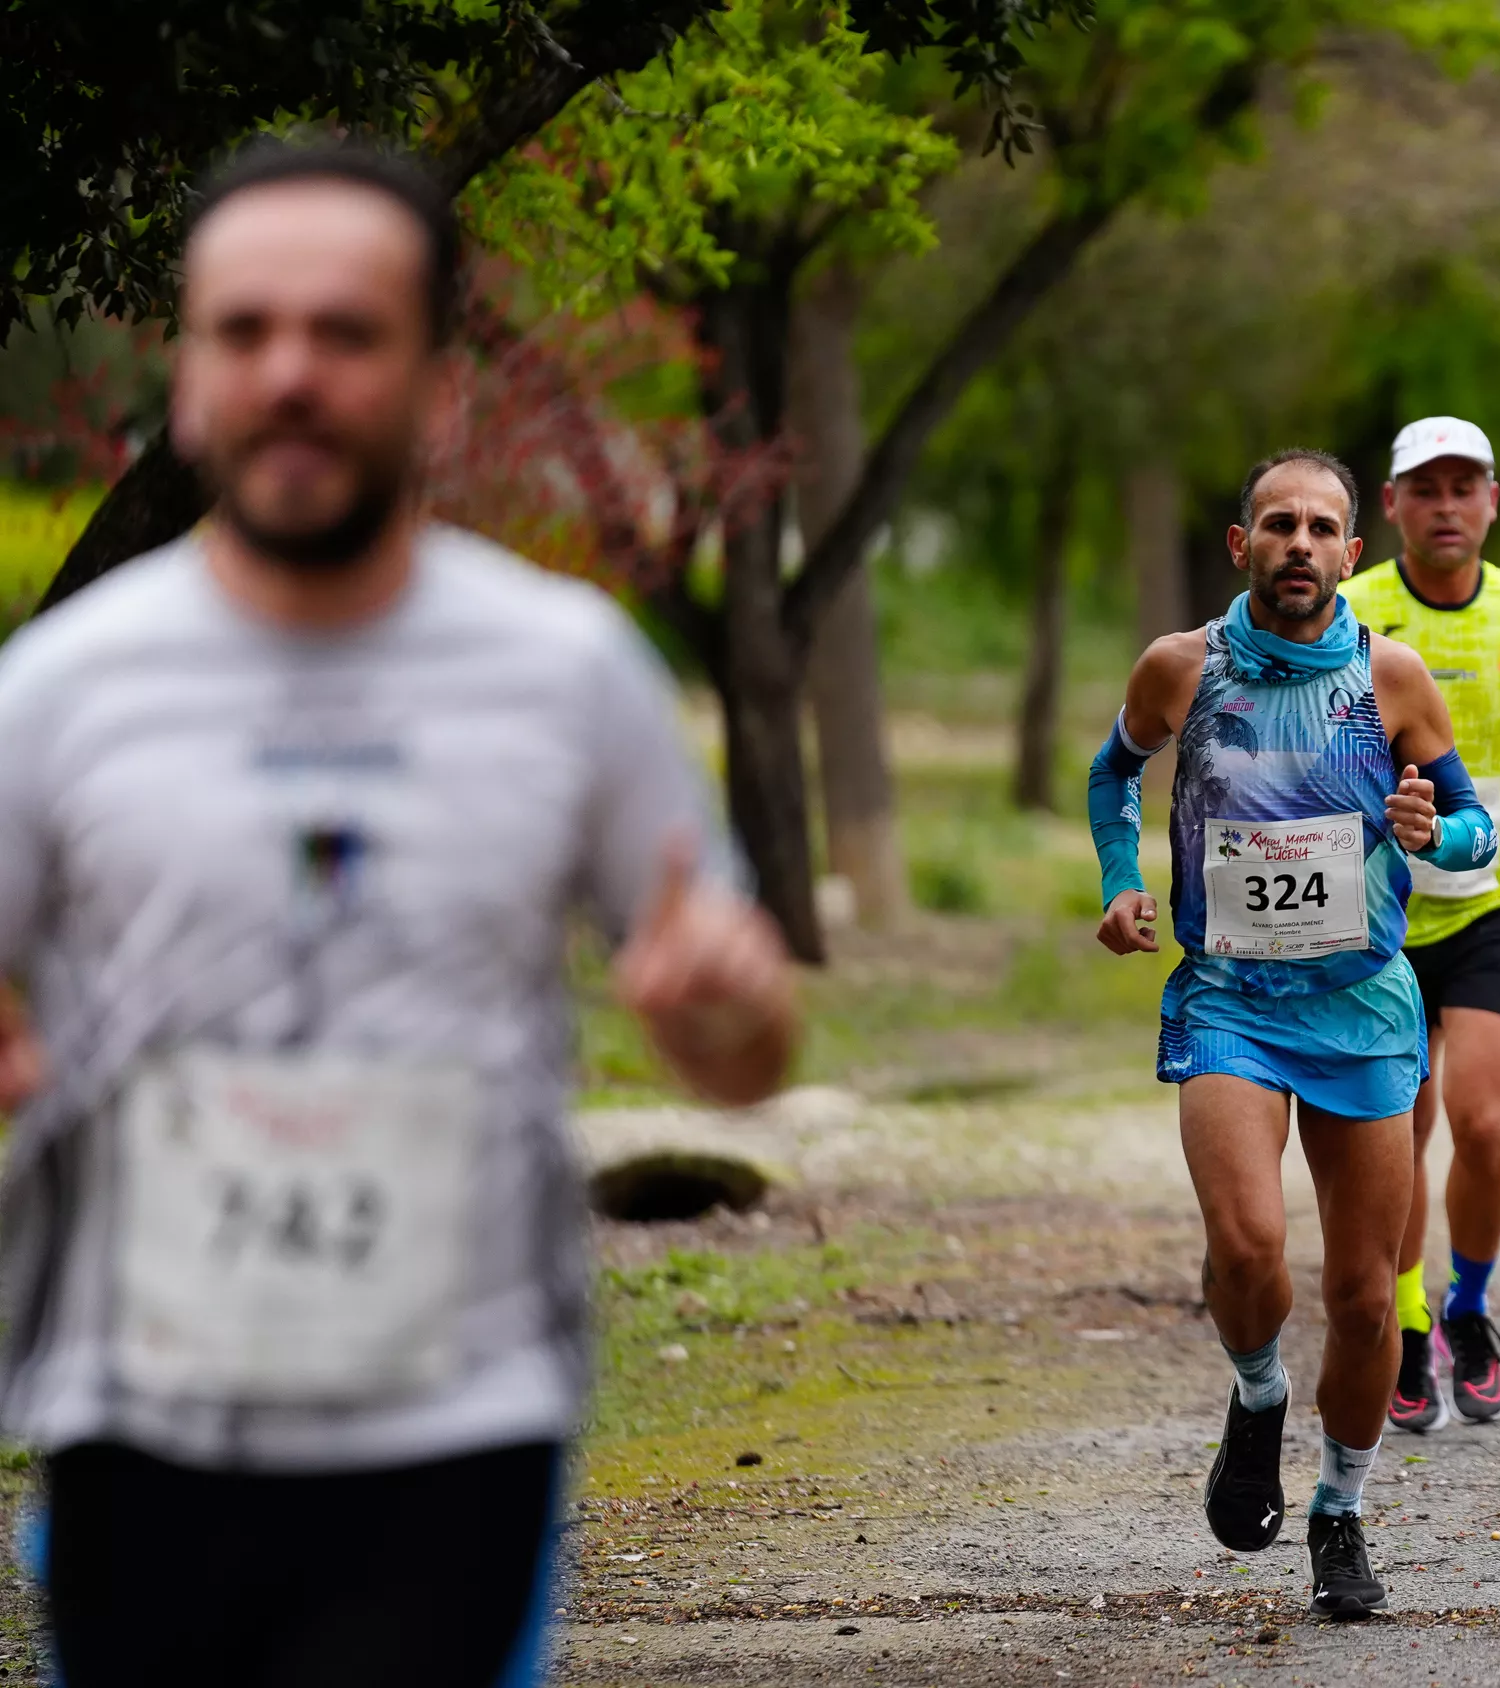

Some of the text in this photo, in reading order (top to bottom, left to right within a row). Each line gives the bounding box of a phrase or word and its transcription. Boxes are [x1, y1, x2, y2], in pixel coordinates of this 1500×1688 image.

[1223, 702, 1255, 712] HORIZON
[1265, 847, 1315, 861] LUCENA
[1245, 872, 1328, 912] 324
